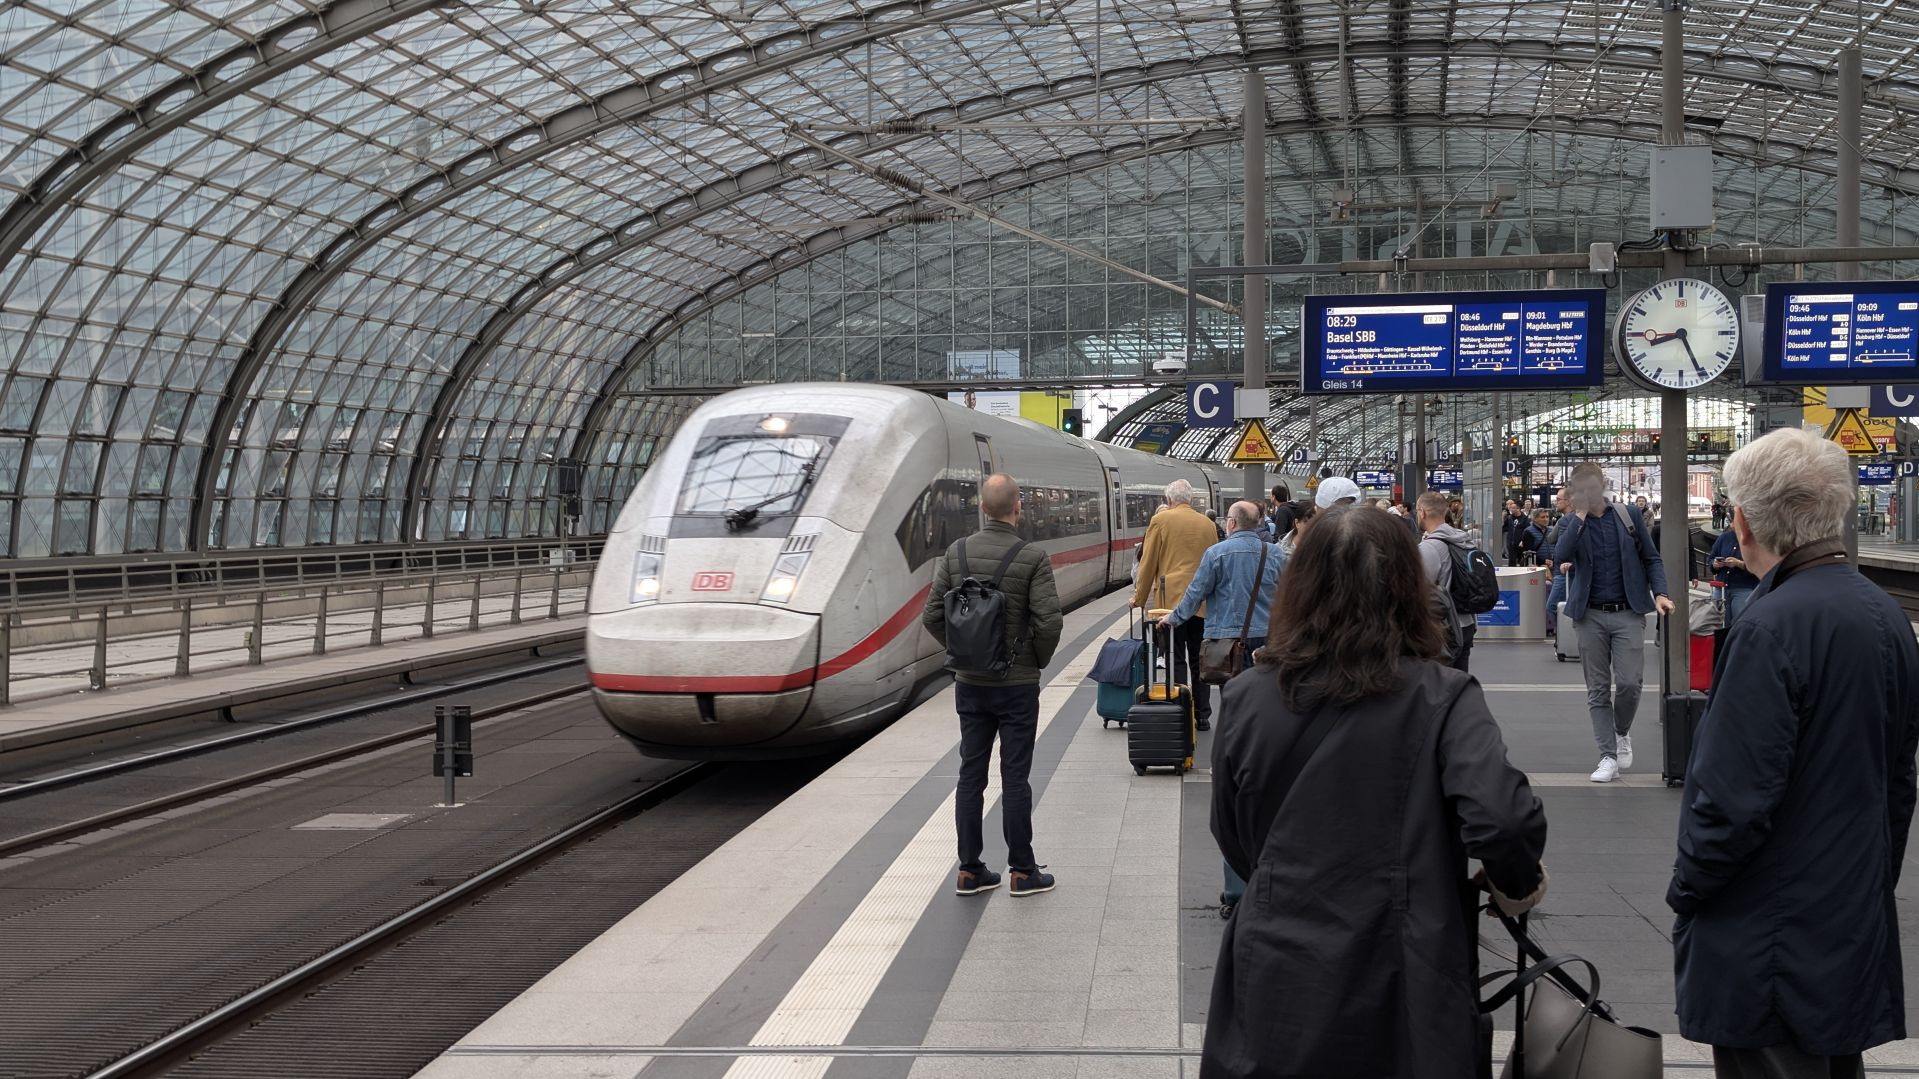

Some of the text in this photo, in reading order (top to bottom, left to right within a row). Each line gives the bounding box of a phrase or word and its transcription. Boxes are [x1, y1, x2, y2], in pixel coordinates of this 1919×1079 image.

[1327, 316, 1356, 327] 08:29
[1526, 322, 1560, 330] Magdeburg
[1327, 330, 1376, 343] Basel SBB
[1322, 380, 1362, 390] Gleis 14
[1194, 383, 1219, 418] C
[1294, 450, 1302, 460] D
[1386, 452, 1396, 460] 14
[1440, 450, 1448, 460] 13
[1506, 462, 1515, 472] D
[1904, 462, 1914, 474] D
[696, 574, 730, 589] DB
